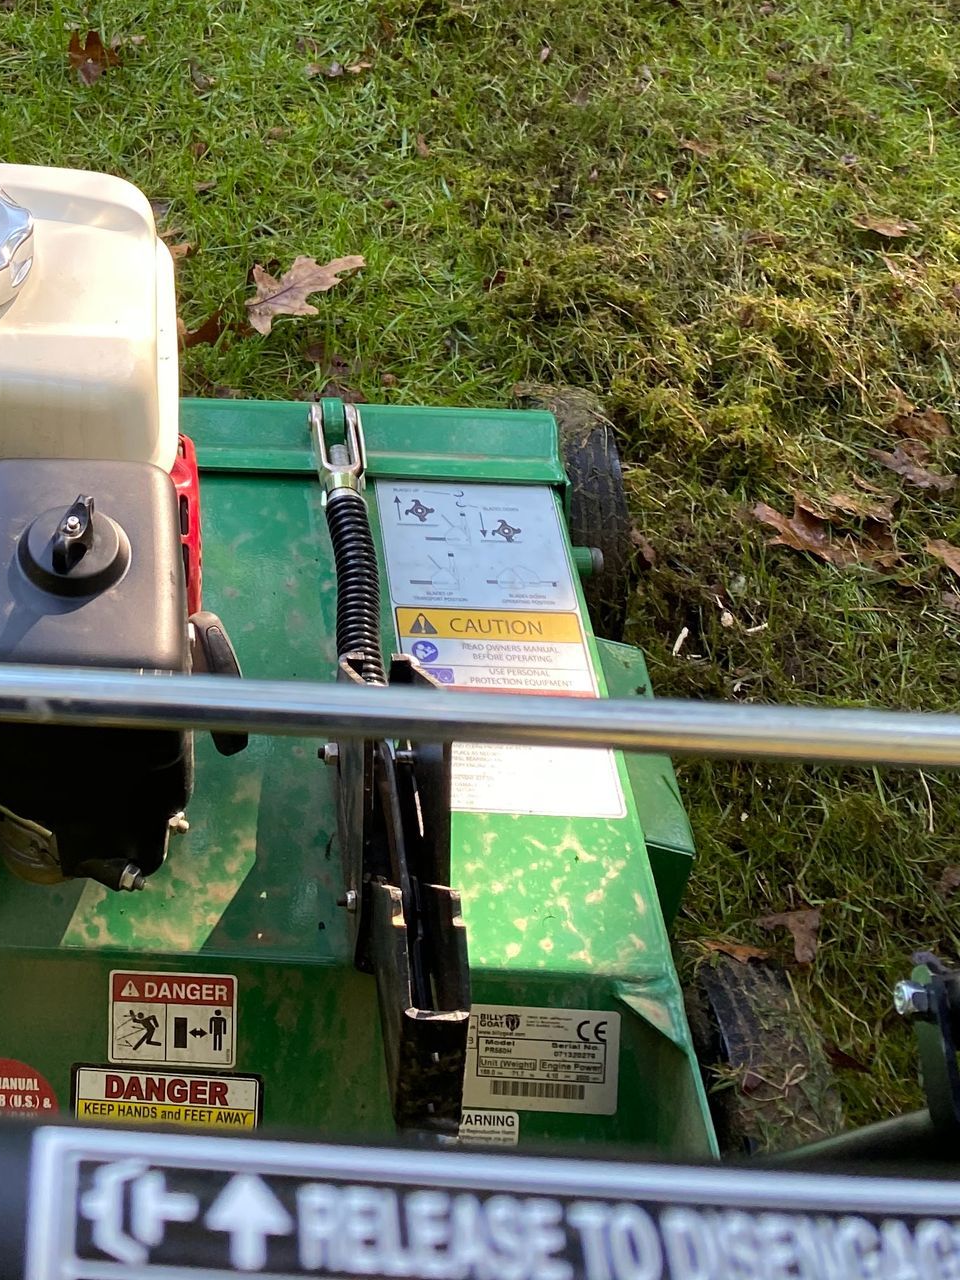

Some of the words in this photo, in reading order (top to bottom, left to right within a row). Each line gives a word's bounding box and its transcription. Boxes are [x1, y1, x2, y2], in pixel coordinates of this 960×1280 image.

[450, 617, 543, 635] CAUTION
[462, 642, 484, 651] READ
[486, 644, 521, 652] OWNERS
[523, 645, 559, 653] MANUAL
[473, 653, 504, 661] BEFORE
[506, 654, 553, 662] OPERATING
[489, 668, 504, 676] USE
[506, 669, 551, 677] PERSONAL
[470, 677, 524, 686] PROTECTION
[525, 678, 573, 688] EQUIPMENT
[144, 982, 228, 1001] DANGER
[481, 1059, 498, 1067] Unit
[500, 1060, 536, 1070] (Weight)
[542, 1062, 571, 1071] Engine
[574, 1064, 602, 1072] Power
[104, 1074, 229, 1106] DANGER
[9, 1094, 40, 1109] (U.S.)
[43, 1098, 52, 1108] &
[84, 1103, 115, 1115] KEEP
[117, 1106, 157, 1119] HANDS
[160, 1108, 180, 1120] and
[184, 1109, 213, 1122] FEET
[216, 1111, 249, 1125] AWAY
[462, 1114, 515, 1127] ARNING
[295, 1182, 575, 1280] RELEASE
[565, 1199, 664, 1280] TO
[659, 1206, 960, 1280] DISENGAG
